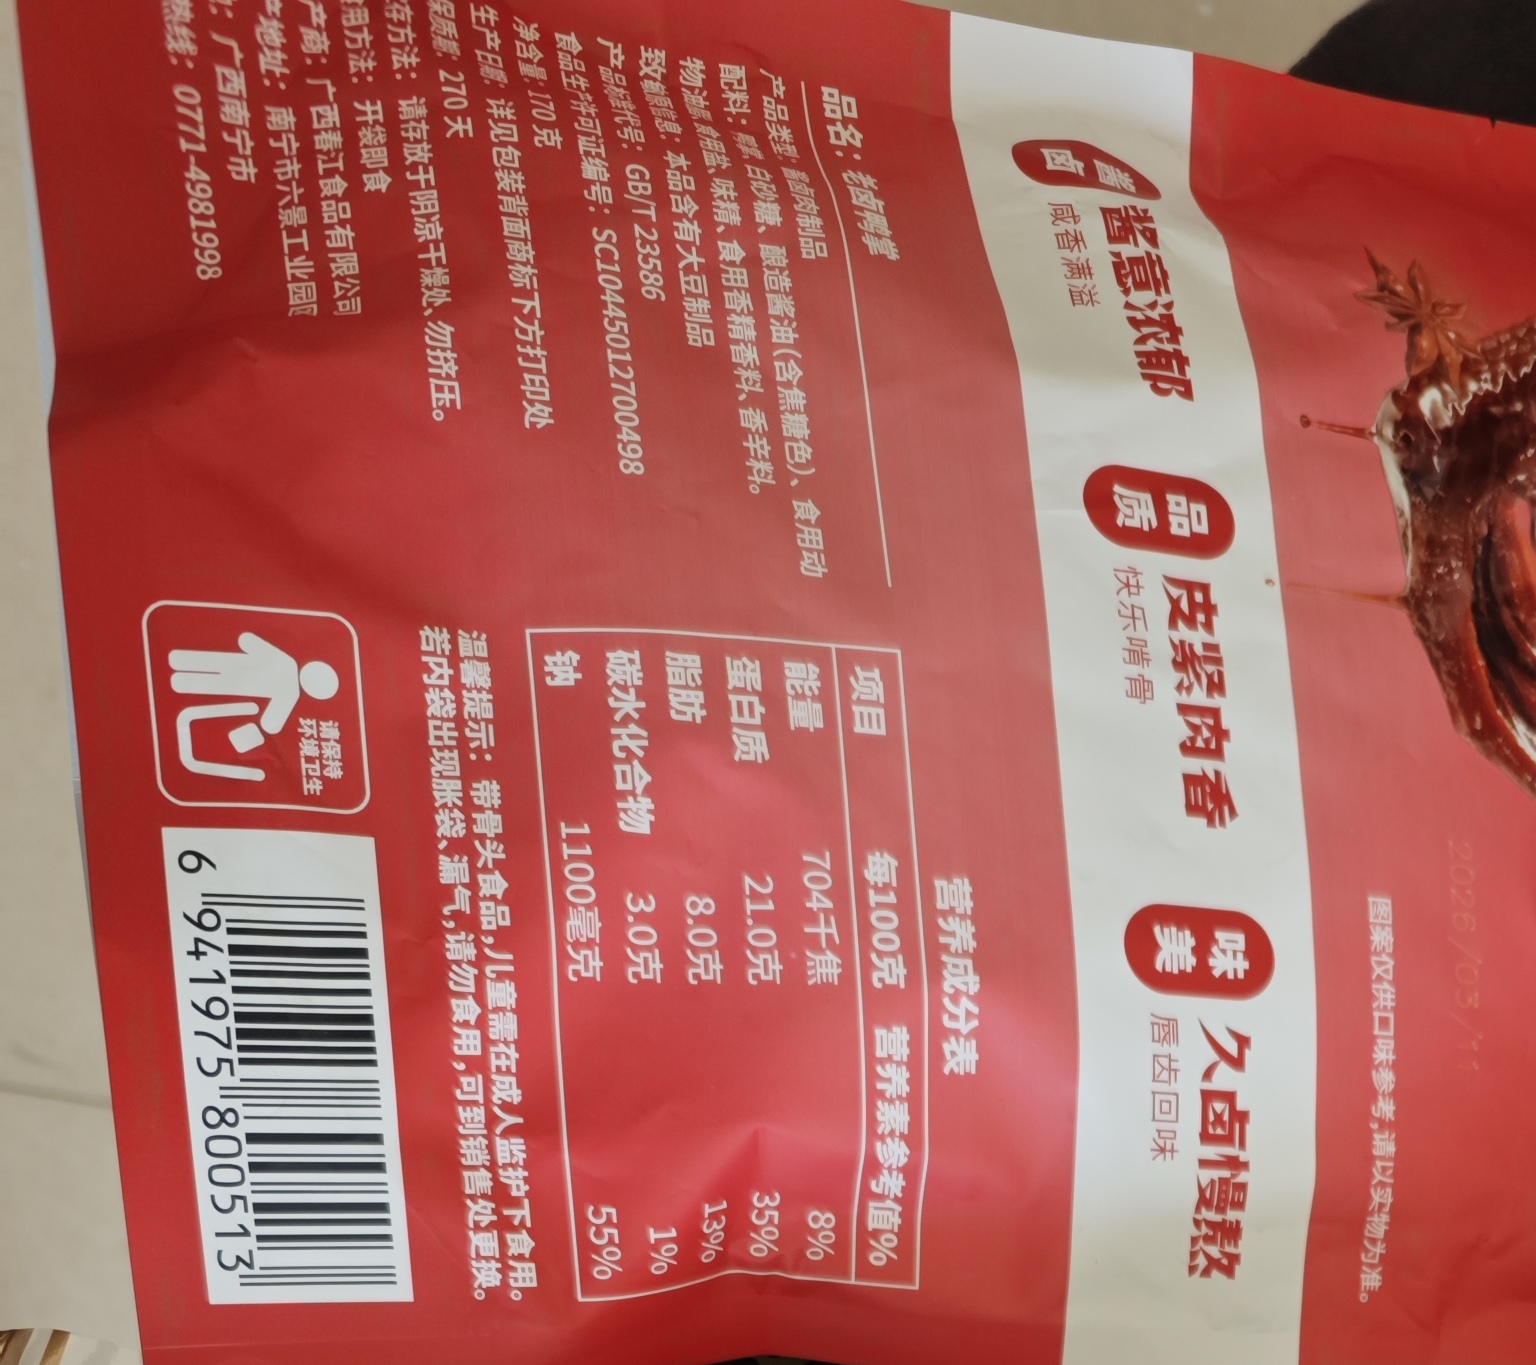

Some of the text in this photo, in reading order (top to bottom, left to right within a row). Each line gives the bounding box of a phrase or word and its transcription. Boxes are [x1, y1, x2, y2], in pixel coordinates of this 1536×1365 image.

[341, 0, 392, 193] 用方法：开袋即食
[1046, 201, 1098, 309] 咸香满溢
[1101, 204, 1199, 398] 酱意浓郁
[1110, 483, 1209, 538] 品质
[1112, 565, 1154, 706] 快乐啃骨
[1161, 572, 1232, 829] 皮紧肉香
[298, 717, 324, 795] 环境卫生
[319, 720, 343, 779] 请保持
[178, 849, 217, 874] 6
[666, 651, 726, 1263] 脂肪 8.0克 13%
[725, 656, 780, 1257] 蛋白质 21.0克 35%
[1150, 923, 1249, 978] 味美
[544, 652, 620, 1279] 钠 1100毫克 55%
[605, 651, 678, 1275] 碳水化合物 3.0克 1%
[785, 662, 841, 1260] 能量 704千焦 8%
[851, 667, 911, 1266] 项目 每100克 营养素参考值%
[935, 876, 978, 1075] 营养成分表
[1146, 1012, 1182, 1163] 唇齿回味
[1186, 1019, 1253, 1280] 久卤慢熬
